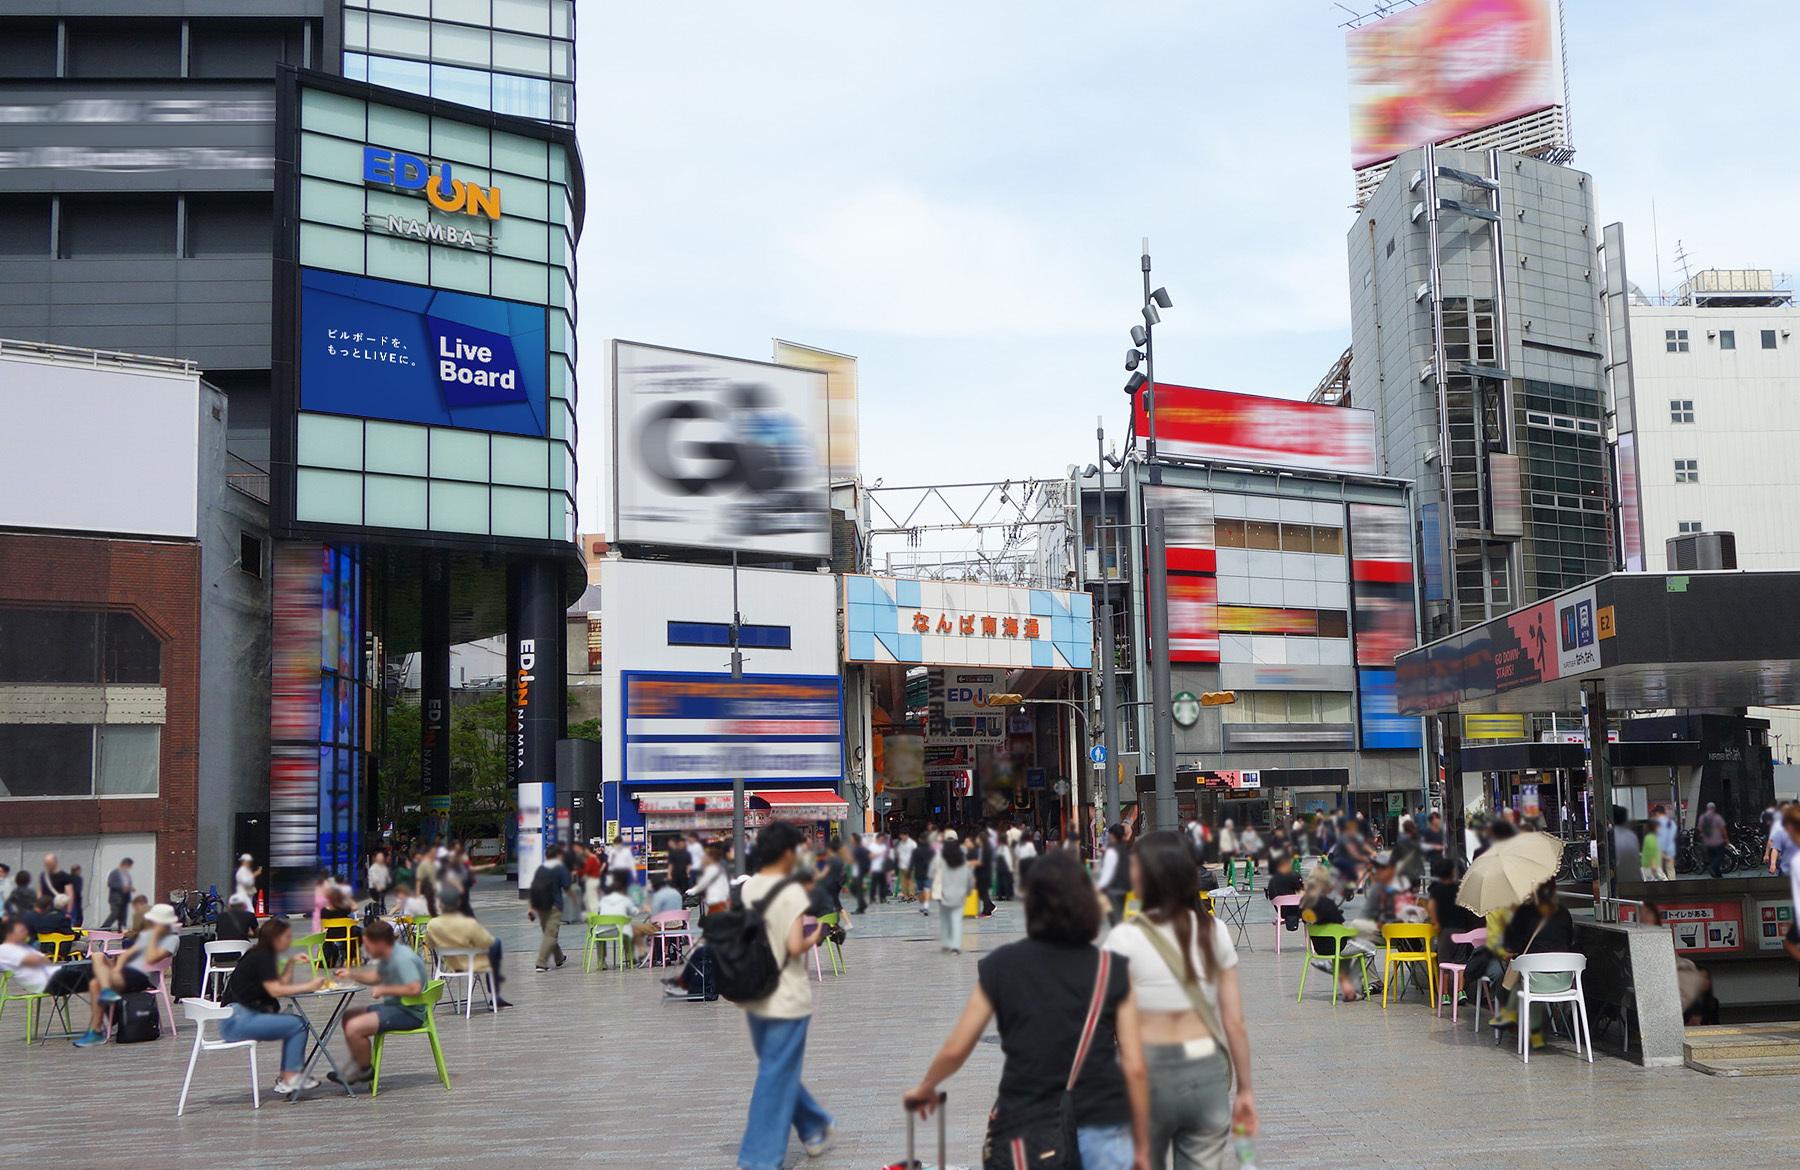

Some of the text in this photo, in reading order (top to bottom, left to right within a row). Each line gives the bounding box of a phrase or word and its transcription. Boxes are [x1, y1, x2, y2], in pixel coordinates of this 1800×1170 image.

[363, 146, 501, 221] EDION
[388, 215, 475, 247] NAMBA
[327, 329, 408, 349] ビルボードを、
[439, 336, 492, 363] Live
[327, 344, 416, 367] もっとLIVEに。
[439, 359, 516, 390] Board
[913, 611, 1040, 639] なんば南海通
[1600, 615, 1610, 631] E2
[1495, 651, 1503, 666] GO
[518, 639, 535, 706] EDION
[1496, 665, 1515, 680] STAIRS!
[948, 688, 989, 708] EDIO
